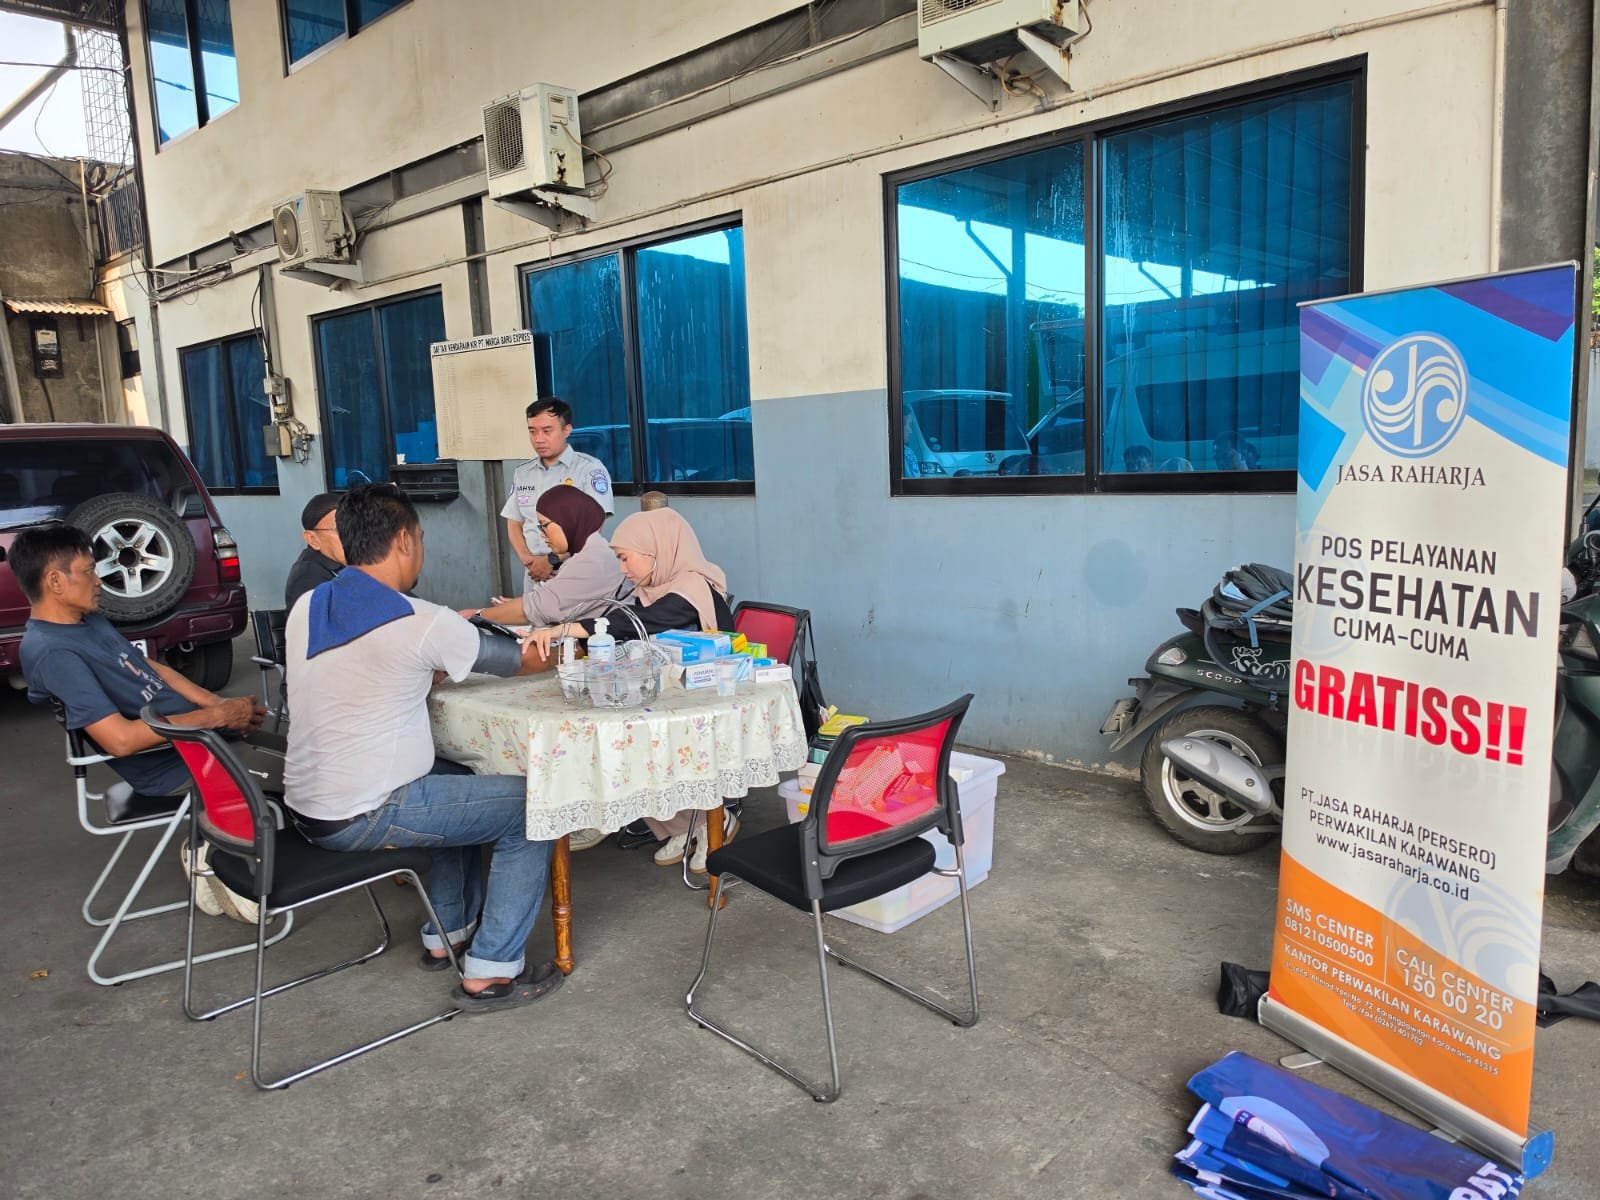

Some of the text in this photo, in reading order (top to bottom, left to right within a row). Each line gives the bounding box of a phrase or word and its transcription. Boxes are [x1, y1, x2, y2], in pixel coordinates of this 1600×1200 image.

[1336, 464, 1487, 490] JASA RAHARJA
[1321, 535, 1497, 575] POS PELAYANAN
[1296, 562, 1540, 638] KESEHATAN
[1333, 616, 1470, 662] CUMA-CUMA
[1294, 658, 1527, 766] GRATISS!!
[1310, 809, 1480, 884] PERWAKILAN KARAWANG
[1316, 832, 1470, 901] www.jasaraharja.co.id
[1353, 804, 1415, 838] RAHARJA
[1417, 825, 1496, 870] (PERSERO)
[1285, 898, 1375, 950] SMS CENTER
[1285, 916, 1374, 967] 081210500500
[1284, 943, 1502, 1061] KANTOR PERWAKILAN KARAWANG
[1396, 947, 1514, 1015] CALL CENTER
[1402, 968, 1503, 1031] 150 00 20
